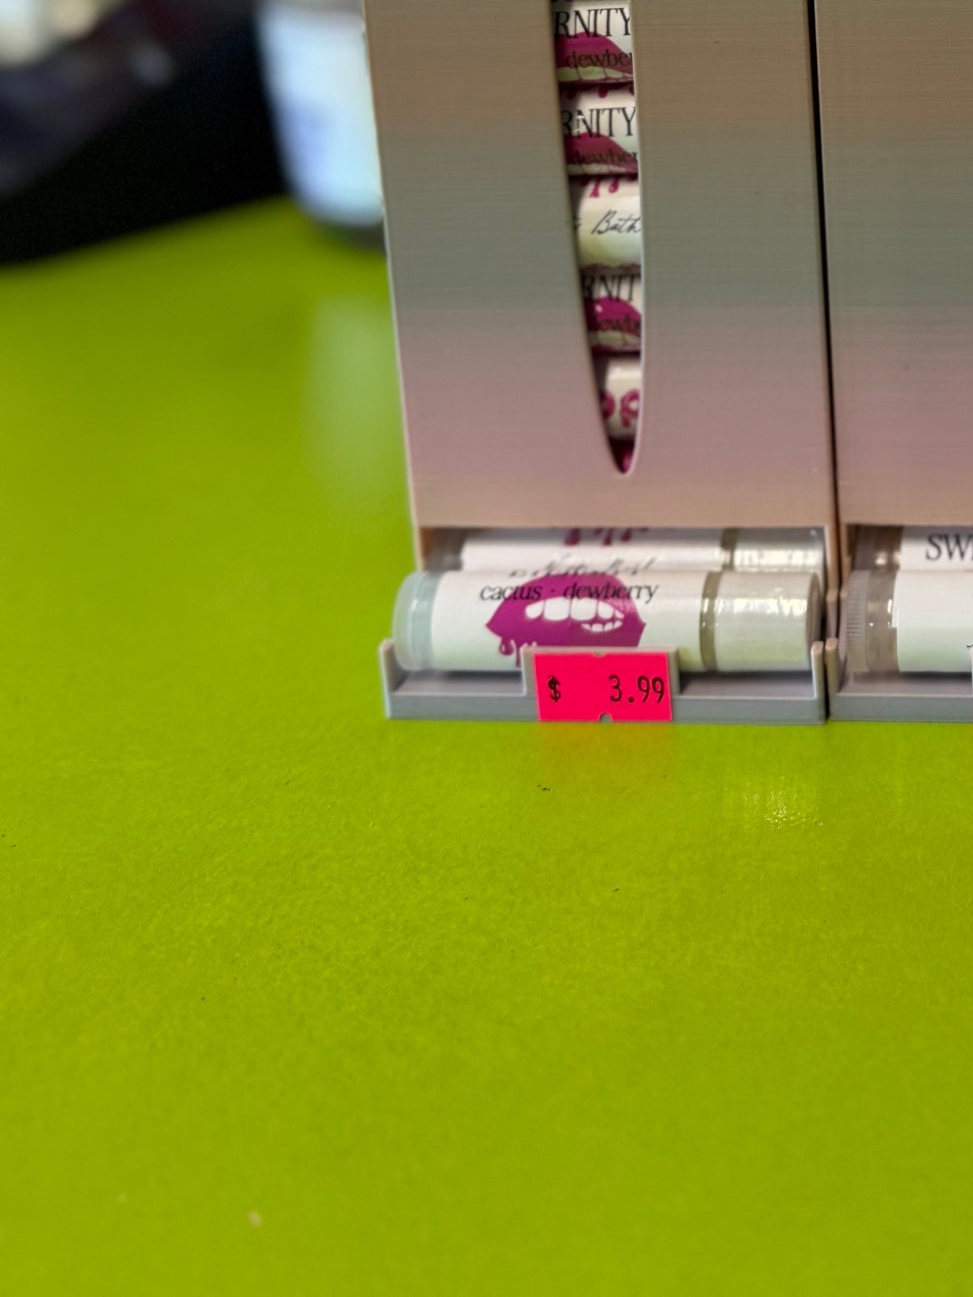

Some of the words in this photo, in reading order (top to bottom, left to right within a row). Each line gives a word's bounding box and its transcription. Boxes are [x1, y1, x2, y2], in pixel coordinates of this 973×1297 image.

[554, 7, 631, 40] RNITY
[591, 210, 640, 234] Bath
[479, 584, 542, 601] cactus
[563, 582, 658, 605] dewberry
[547, 675, 561, 702] $
[608, 674, 665, 703] 3.99
